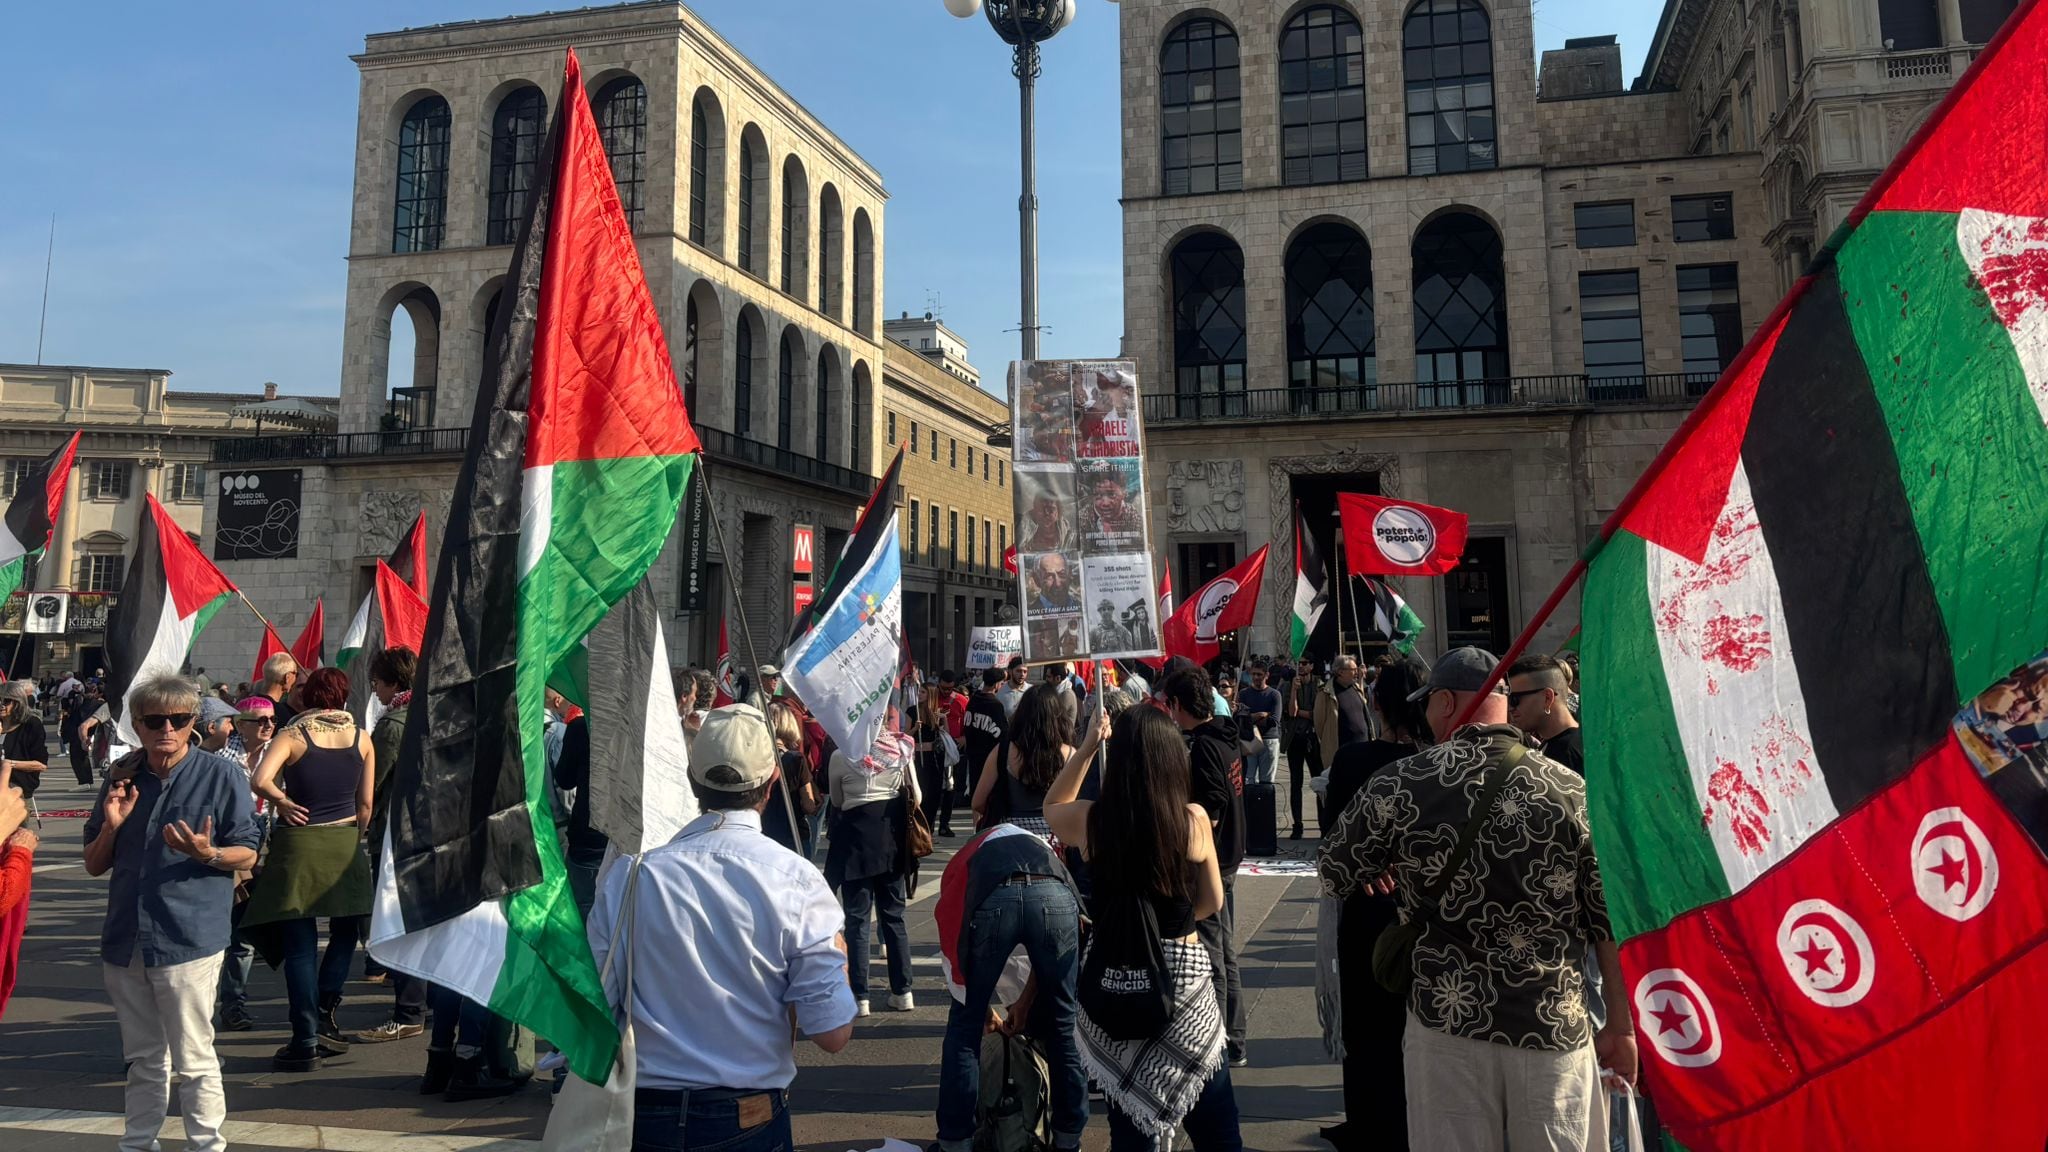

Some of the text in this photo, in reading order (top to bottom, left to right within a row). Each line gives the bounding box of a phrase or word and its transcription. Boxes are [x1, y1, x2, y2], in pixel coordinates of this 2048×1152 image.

[692, 523, 700, 538] DEL
[1376, 527, 1414, 536] potere
[1386, 533, 1428, 543] popolo!
[795, 532, 812, 562] M
[691, 540, 699, 570] MUSEO
[69, 617, 106, 627] KIEFER
[987, 629, 1012, 640] STOP
[1104, 967, 1148, 980] STO THE
